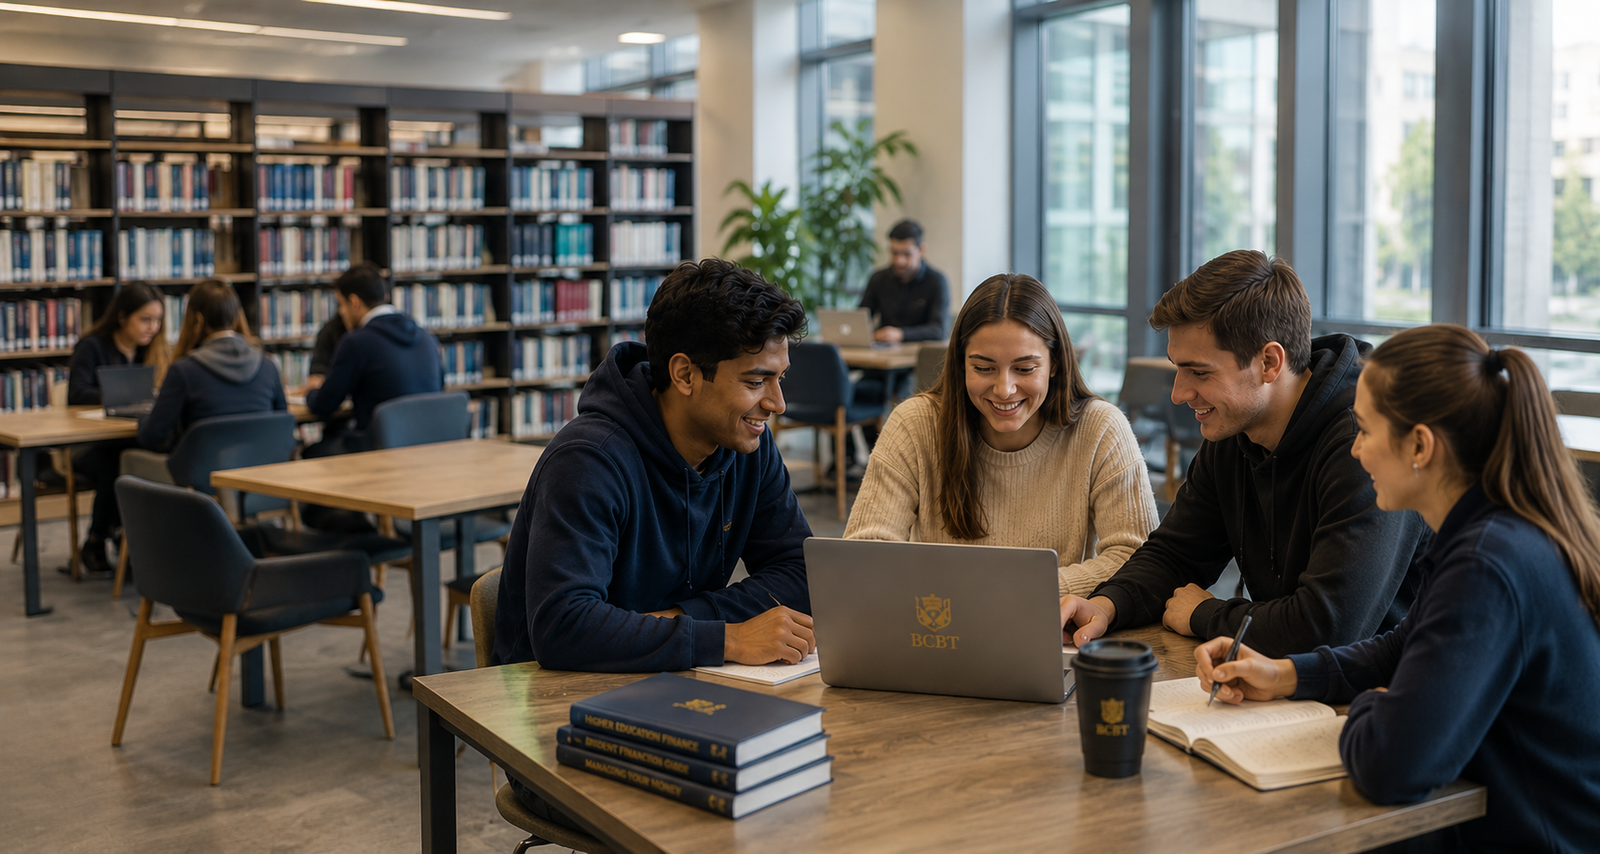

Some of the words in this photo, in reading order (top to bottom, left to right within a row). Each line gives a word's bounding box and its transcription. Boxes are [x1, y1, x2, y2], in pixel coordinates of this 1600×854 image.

[910, 633, 959, 650] BCBT
[585, 714, 614, 730] HIGHER
[615, 721, 661, 743] EDUCATION
[662, 733, 699, 753] FINANCE
[1095, 723, 1130, 737] BCBT
[628, 770, 650, 786] YOUR
[651, 778, 682, 797] MONEY
